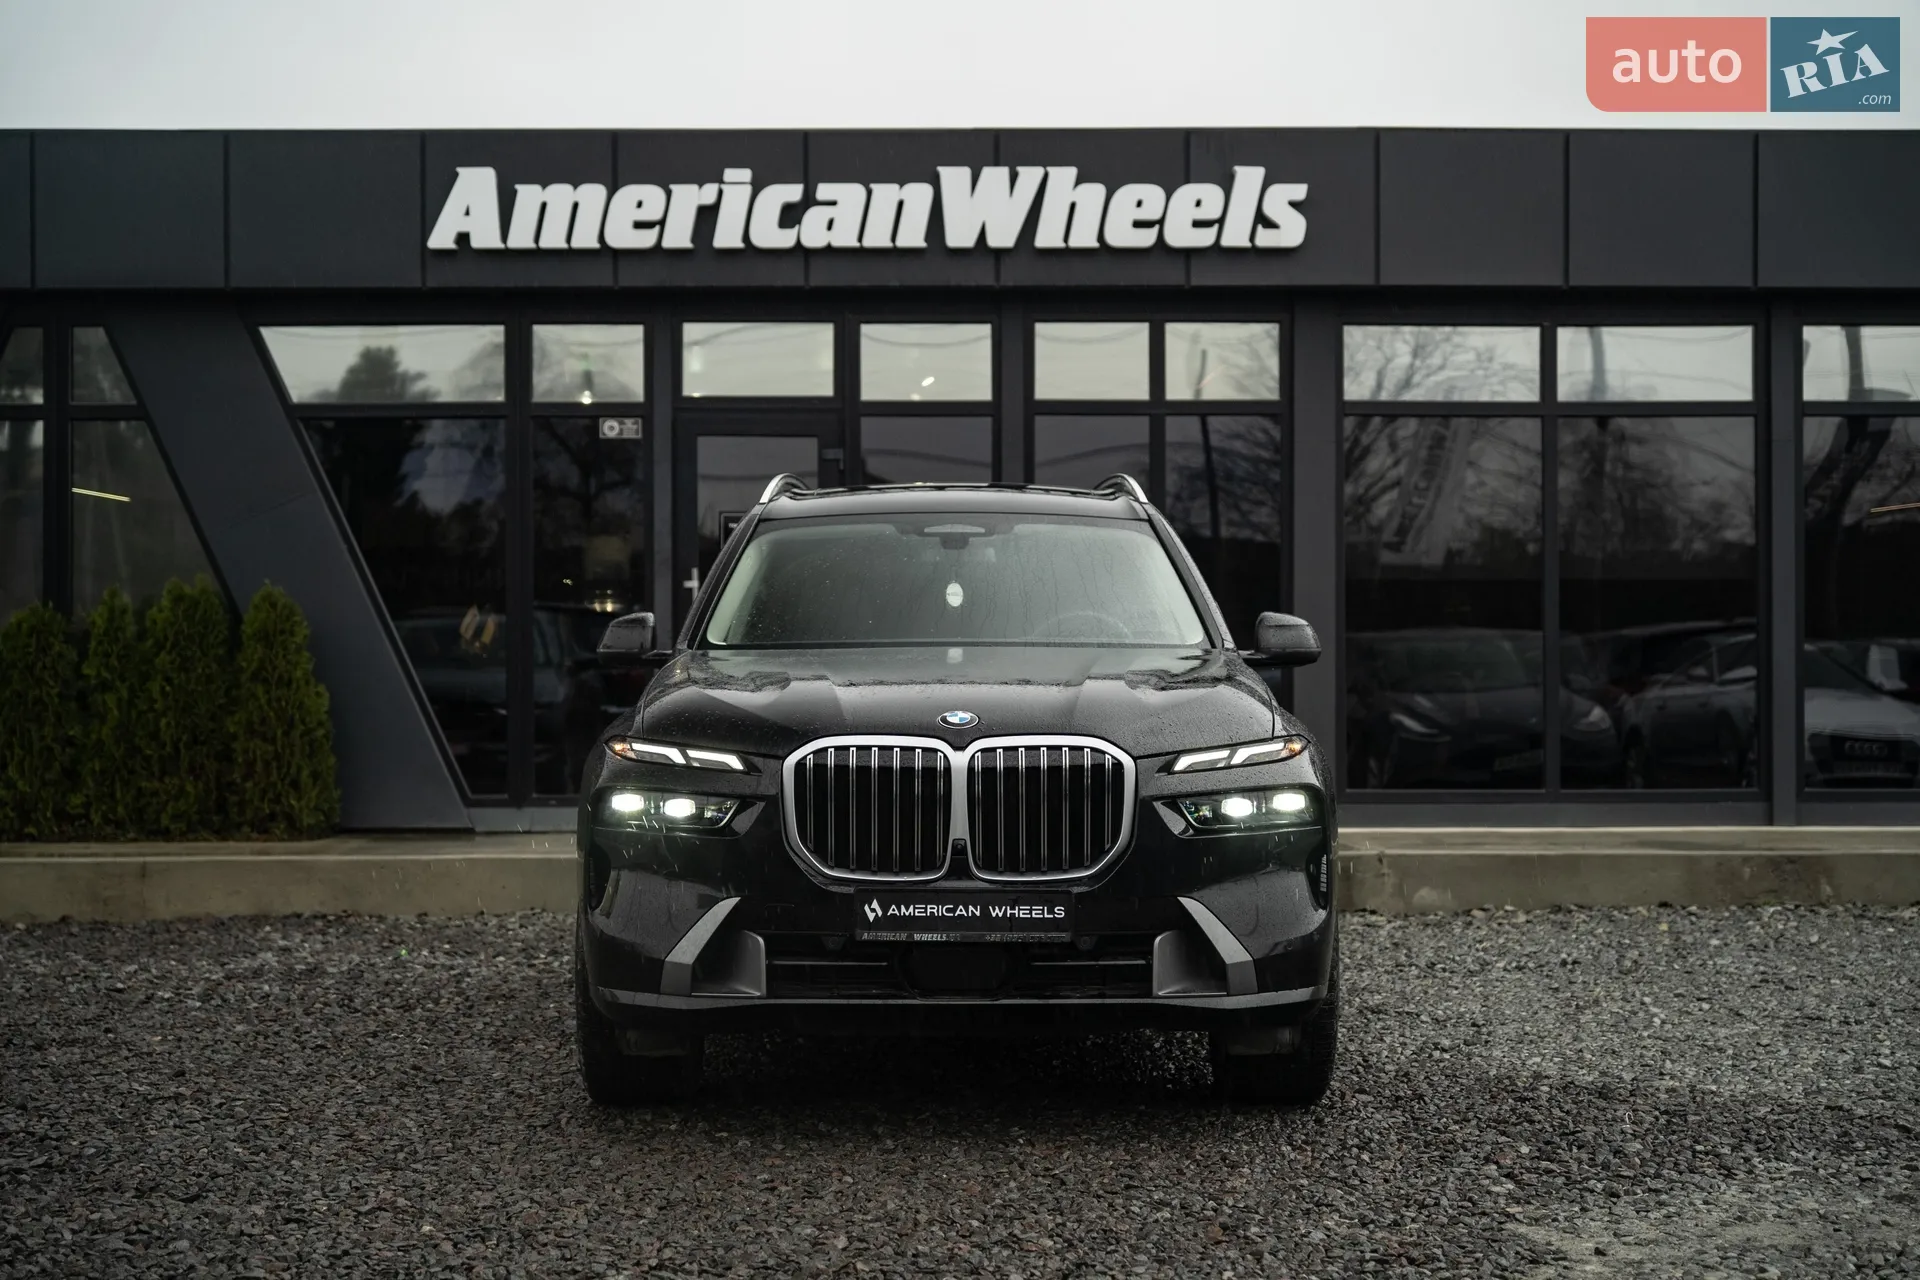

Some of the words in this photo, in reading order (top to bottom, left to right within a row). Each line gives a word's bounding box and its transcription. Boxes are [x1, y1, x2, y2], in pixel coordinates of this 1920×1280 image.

[426, 165, 1310, 250] AmericanWheels
[887, 904, 981, 917] AMERICAN
[988, 905, 1065, 918] WHEELS
